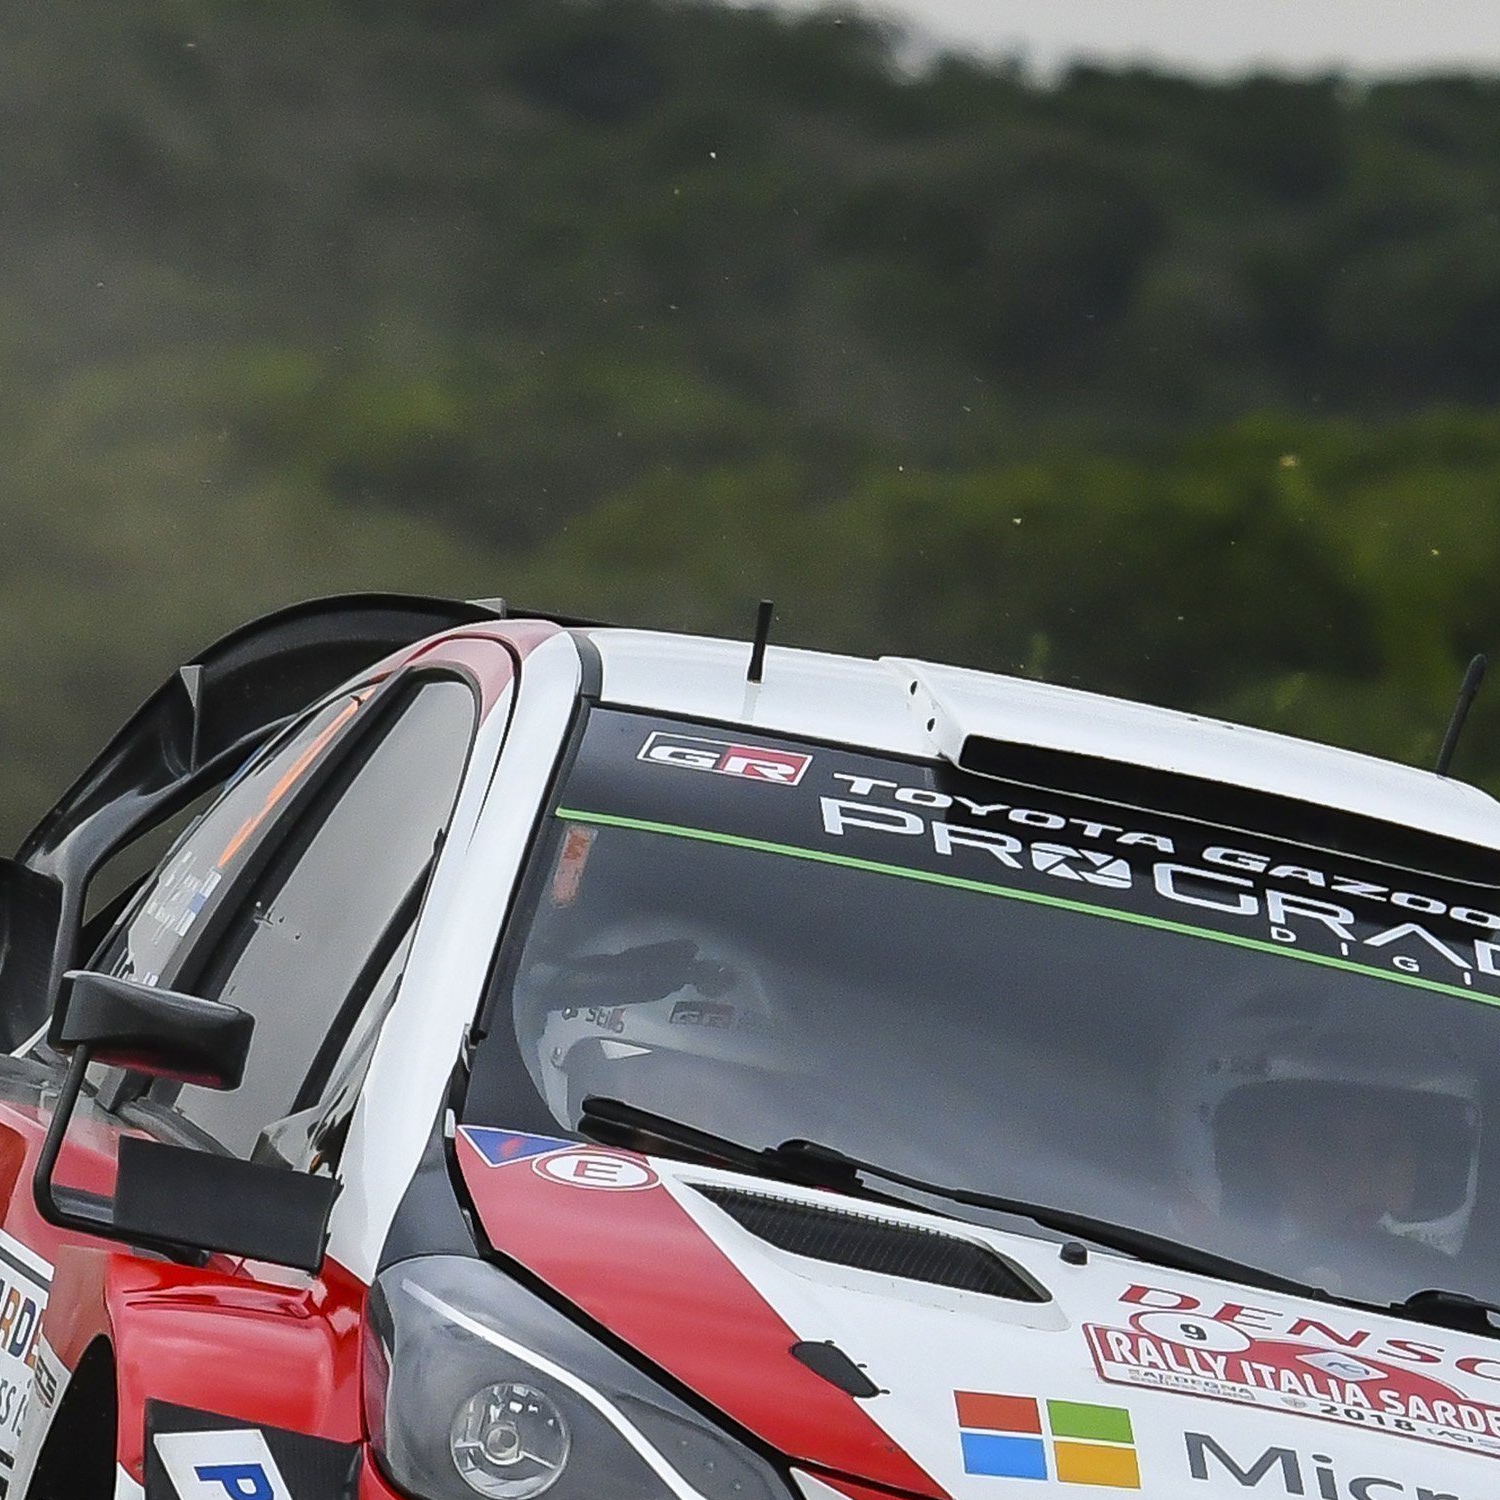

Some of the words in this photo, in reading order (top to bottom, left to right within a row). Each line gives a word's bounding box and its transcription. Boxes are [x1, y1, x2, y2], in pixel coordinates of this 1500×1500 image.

[647, 744, 798, 782] GR
[833, 772, 1176, 854] TOYOTA
[1179, 1322, 1208, 1341] 9
[1105, 1330, 1228, 1382] RALLY
[1239, 1359, 1366, 1410] ITALIA
[1318, 1402, 1417, 1432] 2018
